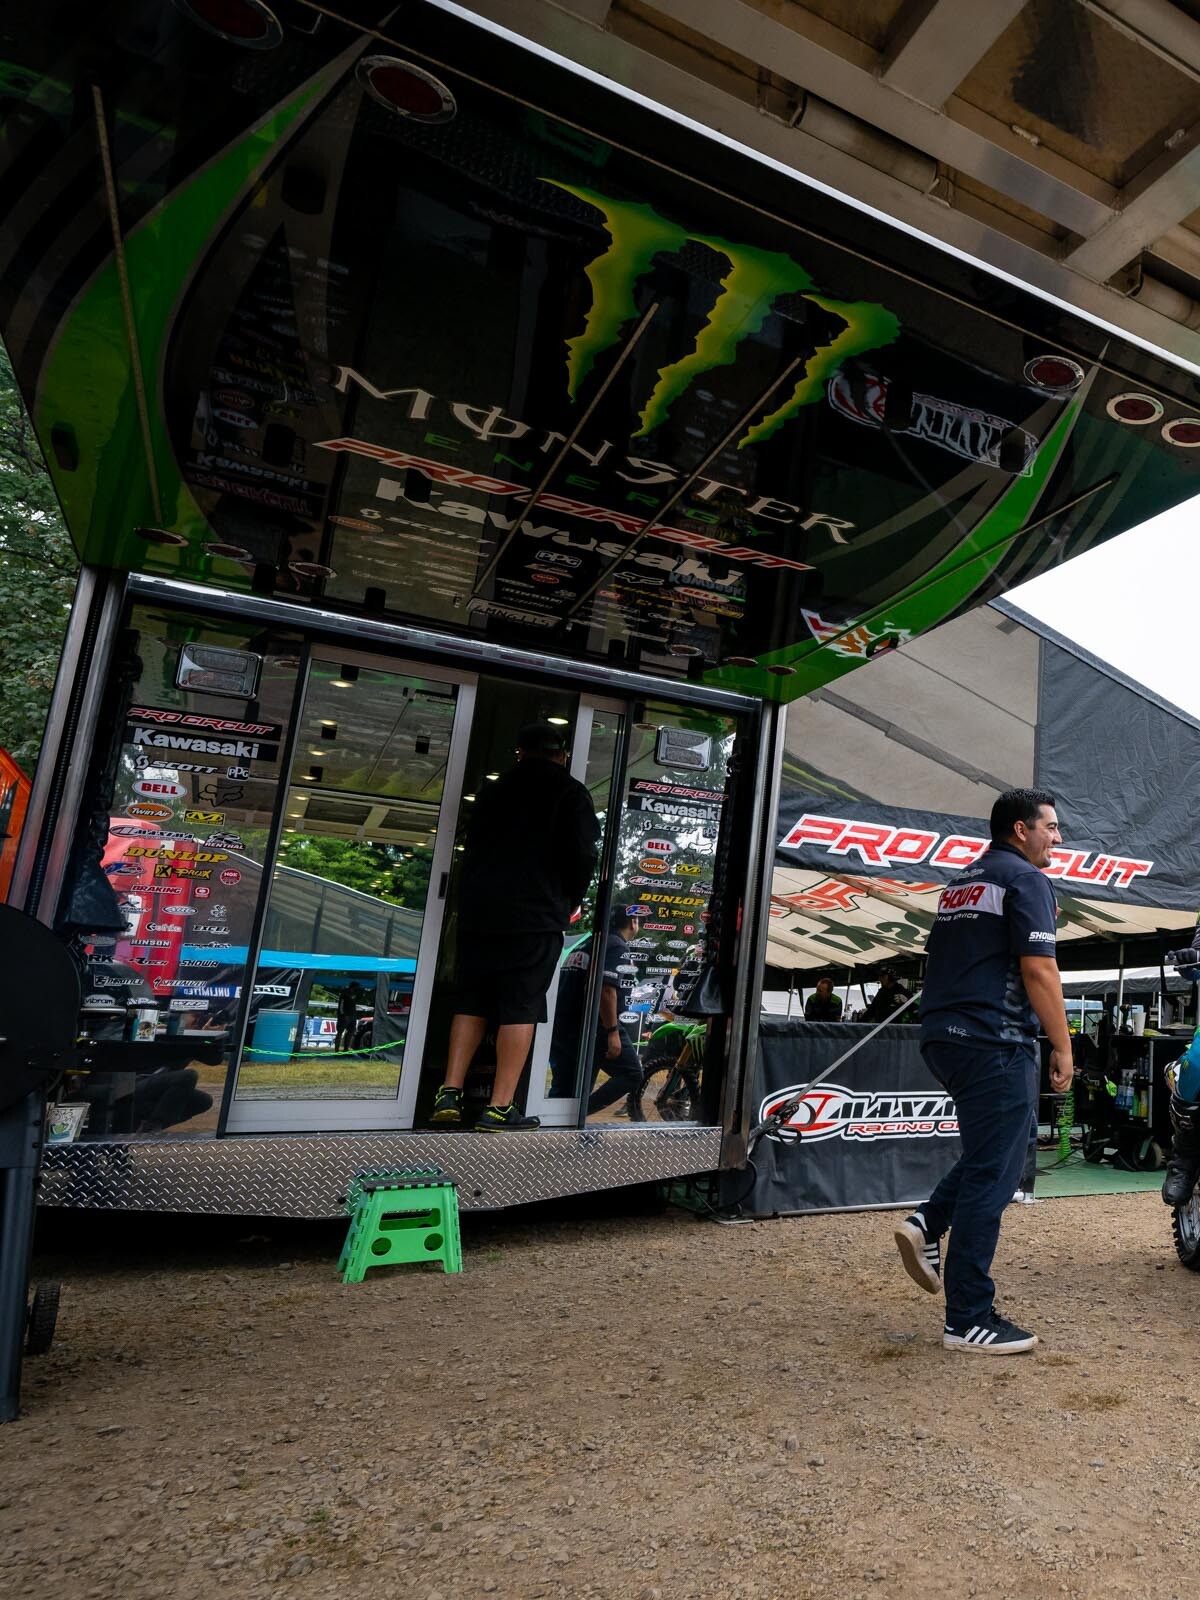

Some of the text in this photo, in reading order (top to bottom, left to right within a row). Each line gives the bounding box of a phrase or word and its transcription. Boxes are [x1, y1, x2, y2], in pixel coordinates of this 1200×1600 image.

[312, 438, 532, 495] PRO
[513, 493, 816, 571] CIRCUIT
[376, 478, 744, 586] Kawasaki
[127, 708, 274, 735] PRO CIRCUIT
[132, 728, 260, 759] Kawasaki
[150, 760, 218, 774] SCOTT
[141, 782, 178, 795] BELL
[635, 781, 729, 801] PRO CIRCUIT
[130, 806, 170, 818] Twin Air
[641, 797, 720, 820] Kawasaki
[647, 841, 671, 851] BELL
[778, 814, 940, 868] PRO
[124, 847, 230, 863] DUNLOP
[131, 885, 182, 895] BRAKING
[639, 893, 705, 905] DUNLOP
[130, 939, 171, 948] HINSON
[88, 955, 114, 964] RK
